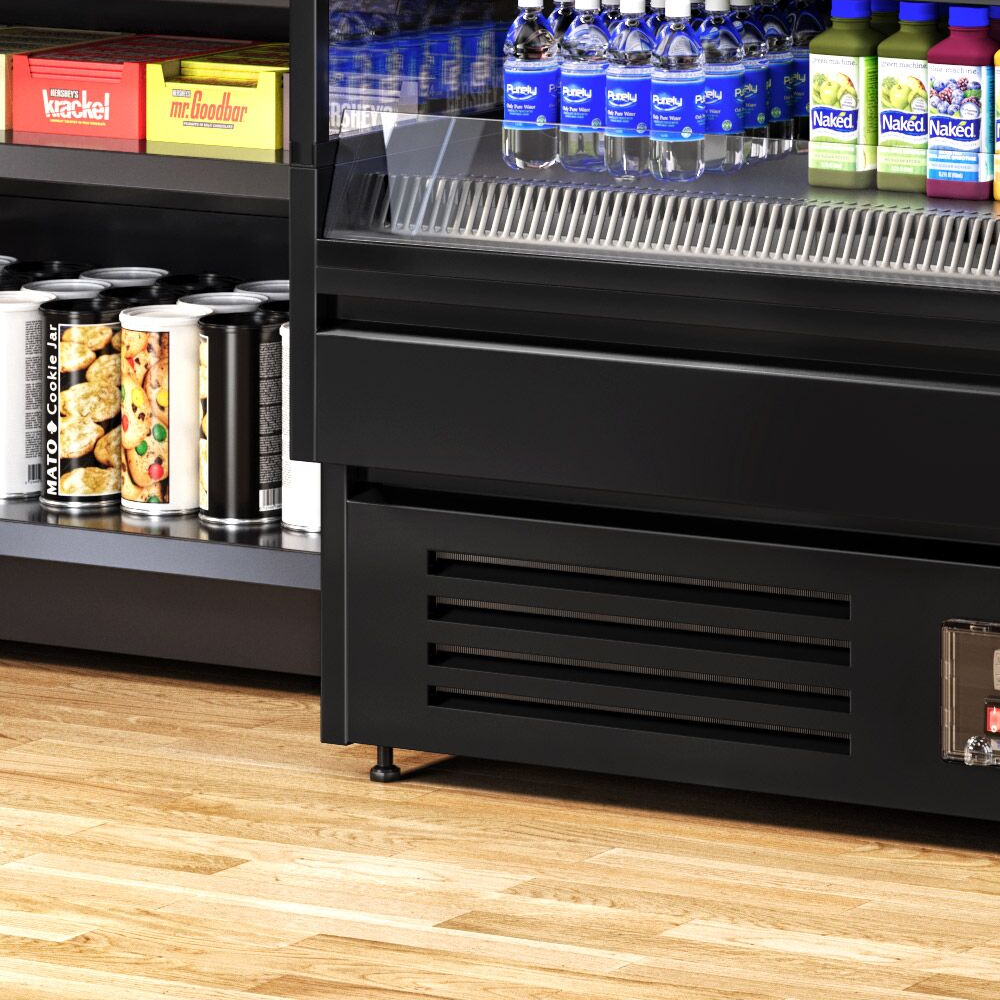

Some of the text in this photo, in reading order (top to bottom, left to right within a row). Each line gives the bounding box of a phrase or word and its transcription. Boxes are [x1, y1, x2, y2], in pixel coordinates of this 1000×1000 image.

[50, 89, 79, 99] HERSHEY'S
[506, 84, 538, 96] Purely
[562, 86, 592, 99] Purely
[608, 90, 638, 103] Purely
[42, 89, 110, 120] krackel
[190, 89, 248, 123] Goodbar
[652, 94, 683, 108] Purely
[330, 102, 392, 129] RSHEY'S
[813, 110, 854, 129] Naked
[882, 114, 925, 133] Naked
[930, 119, 975, 138] Naked
[47, 324, 58, 496] MATO Cookie Jar
